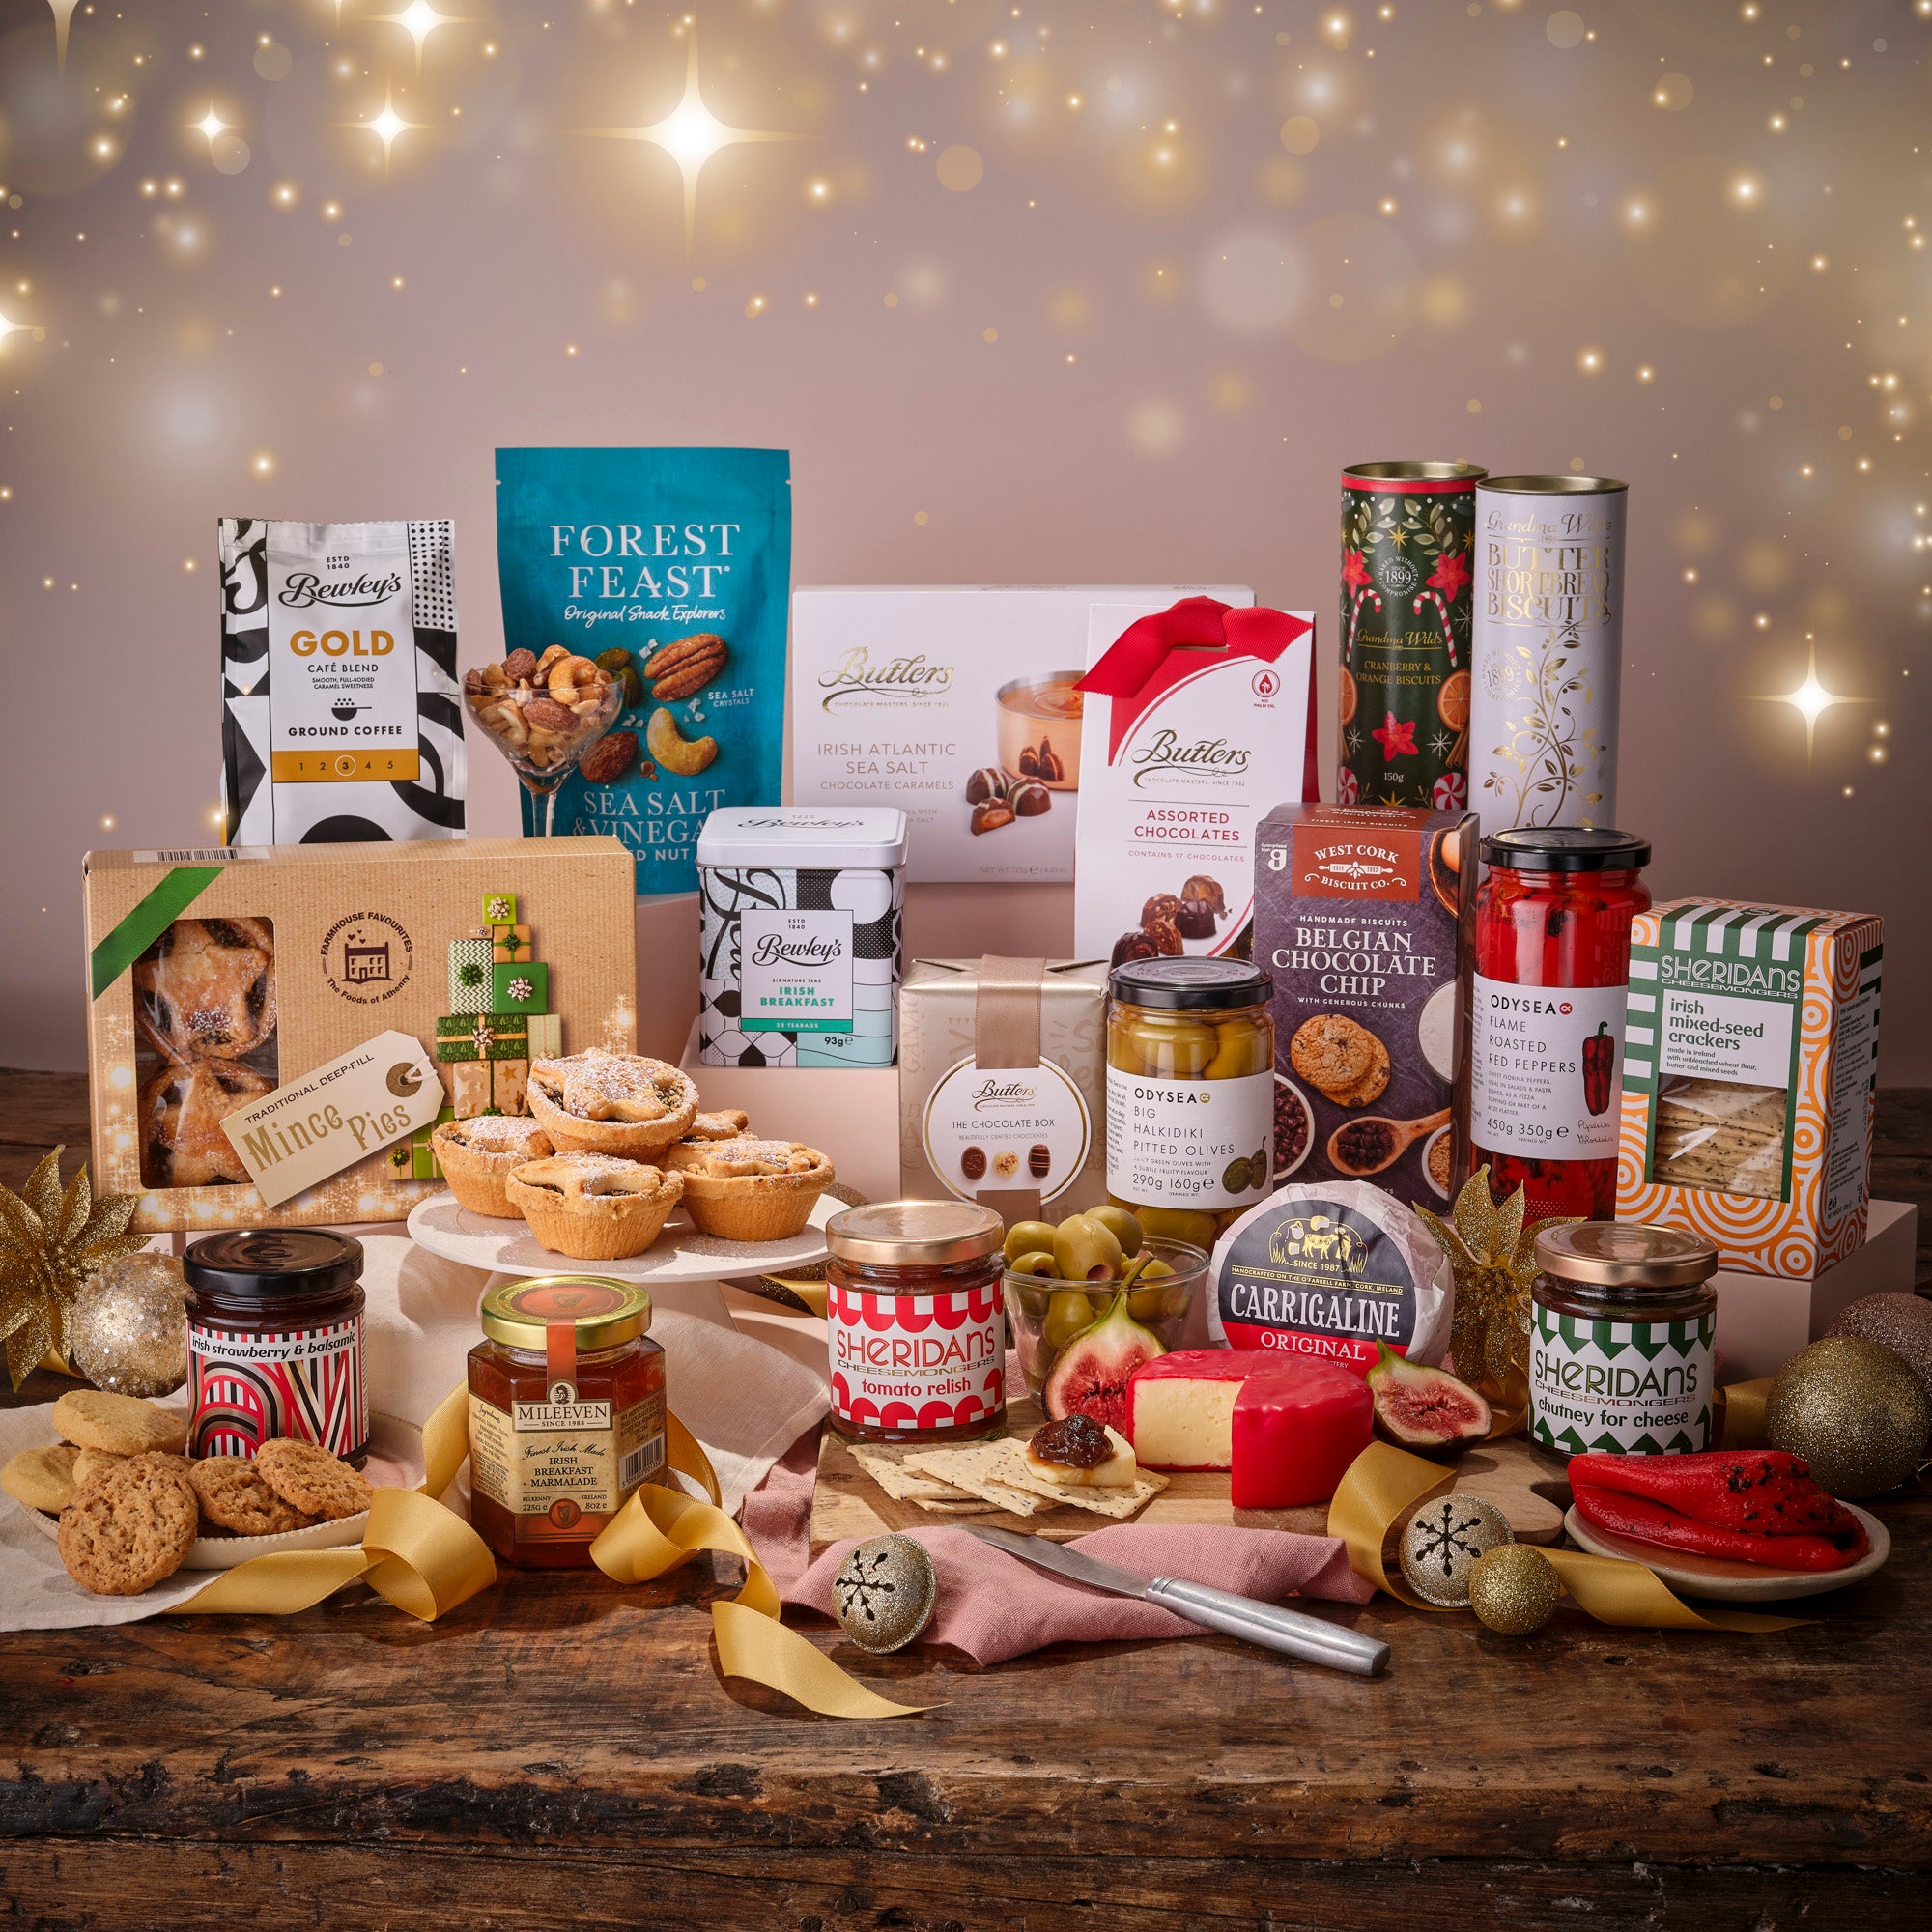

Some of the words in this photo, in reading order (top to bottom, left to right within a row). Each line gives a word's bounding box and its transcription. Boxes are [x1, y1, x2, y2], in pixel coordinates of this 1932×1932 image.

[549, 524, 740, 557] FOREST
[1395, 556, 1419, 578] WITHOUT
[568, 565, 723, 599] FEAST
[1385, 570, 1411, 583] 1899
[278, 572, 402, 608] Bewley's
[1379, 581, 1417, 597] COMPROMISE
[1488, 593, 1611, 620] BISCUITS
[564, 604, 627, 628] Original
[628, 605, 670, 621] Snack
[672, 604, 726, 625] Explorers
[290, 630, 394, 657] GOLD
[1356, 629, 1404, 644] Grandma
[1405, 631, 1443, 645] Wild's
[308, 662, 336, 673] CAFÉ
[342, 664, 379, 673] BLEND
[818, 646, 955, 697] Butlers
[1364, 660, 1422, 671] CRANBERRY
[1423, 662, 1431, 671] &
[1356, 672, 1394, 684] ORANGE
[1396, 675, 1441, 685] BISCUITS
[708, 691, 728, 700] SEA
[731, 688, 754, 698] SALT
[713, 698, 750, 708] CRYSTALS
[288, 726, 349, 737] GROUND
[355, 725, 403, 736] COFFEE
[818, 744, 862, 756] IRISH
[868, 743, 957, 756] ATLANTIC
[1130, 729, 1252, 776] Butlers
[298, 762, 303, 771] 1
[320, 762, 326, 771] 2
[342, 761, 349, 771] 3
[365, 761, 372, 770] 4
[387, 760, 394, 770] 5
[846, 761, 881, 774] SEA
[886, 761, 928, 774] SALT
[820, 781, 891, 790] CHOCOLATE
[895, 781, 954, 790] CARAMELS
[1383, 772, 1405, 782] 150g
[583, 791, 640, 816] SEA
[647, 789, 725, 816] SALT
[1146, 810, 1230, 824] ASSORTED
[1134, 826, 1240, 841] CHOCOLATES
[1128, 850, 1172, 859] CONTAINS
[1187, 853, 1245, 862] CHOCOLATES
[1314, 844, 1353, 861] WEST
[1356, 844, 1399, 864] CORK
[1321, 876, 1368, 890] BISCUIT
[1371, 879, 1390, 889] CO.
[1300, 915, 1356, 924] HANDMADE
[1361, 918, 1407, 927] BISCUITS
[321, 912, 365, 955] FARMHOUSE
[368, 912, 413, 952] FAVOURITES
[1295, 927, 1412, 952] BELGIAN
[752, 934, 841, 966] Bewley's
[1272, 949, 1435, 976] CHOCOLATE
[327, 978, 340, 993] The
[341, 990, 367, 1004] Foods
[382, 974, 410, 1002] Athenry
[779, 986, 815, 996] IRISH
[1321, 974, 1386, 996] CHIP
[1661, 978, 1799, 999] CHEESEMONGERS
[760, 997, 835, 1007] BREAKFAST
[1323, 998, 1368, 1007] GENEROUS
[1491, 995, 1556, 1014] ODYSEA
[1670, 998, 1704, 1015] irish
[1490, 1016, 1526, 1032] FLAME
[1669, 1015, 1764, 1038] mixed-seed
[824, 1037, 843, 1047] 93g
[1490, 1035, 1547, 1053] ROASTED
[1668, 1032, 1741, 1051] crackers
[1489, 1053, 1507, 1066] RED
[1515, 1059, 1576, 1073] PEPPERS
[1682, 1056, 1719, 1066] unbleached
[244, 1083, 319, 1124] TRADITIONAL
[320, 1053, 375, 1086] DEEP-FILL
[971, 1079, 1037, 1102] Butlers
[1134, 1088, 1197, 1104] ODYSEA
[1134, 1106, 1156, 1119] BIG
[952, 1121, 967, 1129] THE
[971, 1120, 1031, 1129] CHOCOLATE
[1035, 1119, 1055, 1127] BOX
[1134, 1125, 1204, 1139] HALKIDIKI
[1487, 1118, 1513, 1136] 450g
[241, 1103, 344, 1172] Mince
[345, 1103, 412, 1151] Pies
[1133, 1141, 1177, 1154] PITTED
[1186, 1144, 1235, 1156] OLIVES
[1132, 1173, 1162, 1190] 290g
[1293, 1259, 1318, 1270] SINCE
[1320, 1263, 1340, 1272] 1987
[1232, 1266, 1275, 1279] HANDCRAFTED
[1301, 1276, 1333, 1286] O'FARRELL
[1231, 1283, 1400, 1338] CARRIGALINE
[192, 1335, 210, 1352] irish
[213, 1346, 290, 1359] strawberry
[294, 1345, 304, 1355] &
[307, 1331, 356, 1354] balsamic
[1261, 1331, 1367, 1361] ORIGINAL
[838, 1356, 995, 1377] CHEESEMONGERS
[862, 1378, 922, 1397] tomato
[927, 1377, 971, 1396] relish
[1535, 1379, 1696, 1406] CHEESEMONGERS
[518, 1405, 608, 1420] MILEEVEN
[1539, 1396, 1595, 1427] chutney
[1600, 1409, 1628, 1427] for
[1633, 1410, 1689, 1428] cheese
[522, 1444, 551, 1461] Finest
[552, 1440, 578, 1453] Irish
[579, 1443, 607, 1457] Made
[549, 1457, 578, 1465] IRISH
[534, 1466, 594, 1476] BREAKFAST
[530, 1477, 598, 1487] MARMALADE
